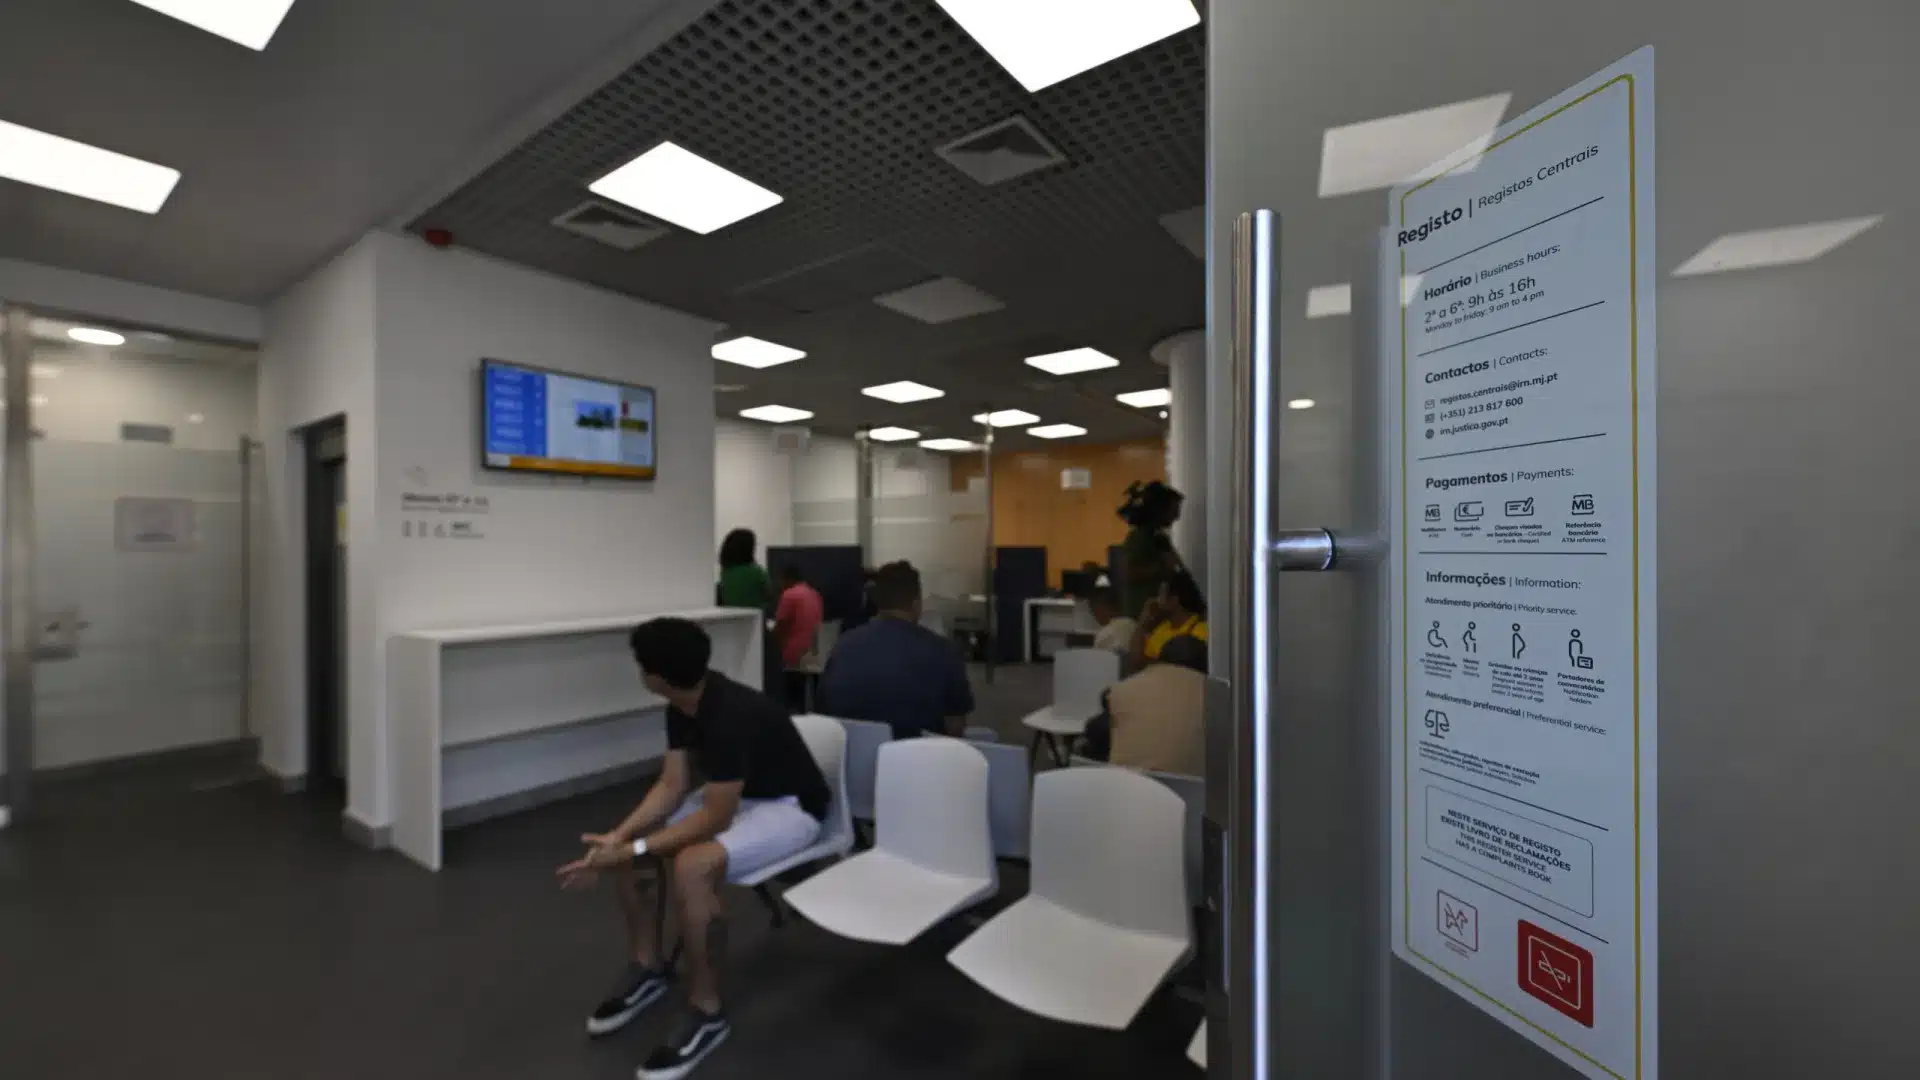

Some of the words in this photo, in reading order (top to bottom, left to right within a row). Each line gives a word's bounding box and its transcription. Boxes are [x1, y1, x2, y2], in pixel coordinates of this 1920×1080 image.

[1397, 207, 1463, 247] Registo
[1478, 175, 1533, 209] Registos
[1537, 144, 1599, 181] Centrais
[1424, 275, 1472, 300] Horário
[1480, 257, 1525, 280] Business
[1527, 244, 1561, 263] hours:
[1425, 319, 1453, 334] Monday
[1454, 316, 1463, 324] to
[1488, 305, 1495, 313] 9
[1496, 302, 1510, 311] am
[1522, 295, 1528, 303] 4
[1529, 290, 1545, 302] pm
[1438, 308, 1447, 319] a
[1468, 294, 1485, 309] 9h
[1488, 289, 1505, 302] às
[1509, 276, 1537, 295] 16h
[1425, 359, 1490, 384] Contactos
[1499, 348, 1548, 366] Contacts:
[1440, 408, 1466, 422] (+351)
[1468, 403, 1484, 415] 213
[1486, 400, 1503, 411] 817
[1506, 396, 1524, 407] 600
[1425, 472, 1508, 490] Pagamentos
[1517, 467, 1574, 482] Payments:
[1424, 507, 1441, 518] MB
[1571, 499, 1595, 511] MB
[1426, 571, 1507, 588] Informações
[1515, 577, 1582, 590] Information:
[1425, 597, 1472, 607] Atendimento
[1473, 600, 1513, 611] prioritário
[1518, 604, 1545, 614] Priority
[1557, 672, 1595, 684] Portadores
[1557, 680, 1605, 692] convocatórias
[1425, 690, 1472, 706] Atendimento
[1473, 701, 1521, 717] preferencial
[1526, 711, 1572, 728] Preferential
[1573, 722, 1607, 736] service:
[1441, 815, 1466, 830] EXISTE
[1467, 824, 1490, 840] LIVRO
[1492, 835, 1503, 845] DE
[1504, 840, 1571, 872] RECLAMAÇÕES
[1448, 809, 1472, 822] NESTE
[1473, 818, 1507, 836] SERVIÇO
[1509, 831, 1521, 842] DE
[1522, 836, 1562, 857] REGISTO
[1460, 832, 1475, 844] THIS
[1476, 837, 1511, 858] REGISTER
[1513, 854, 1547, 872] SERVICE
[1456, 838, 1470, 850] HAS
[1478, 848, 1526, 873] COMPLAINTS
[1527, 868, 1552, 884] BOOK
